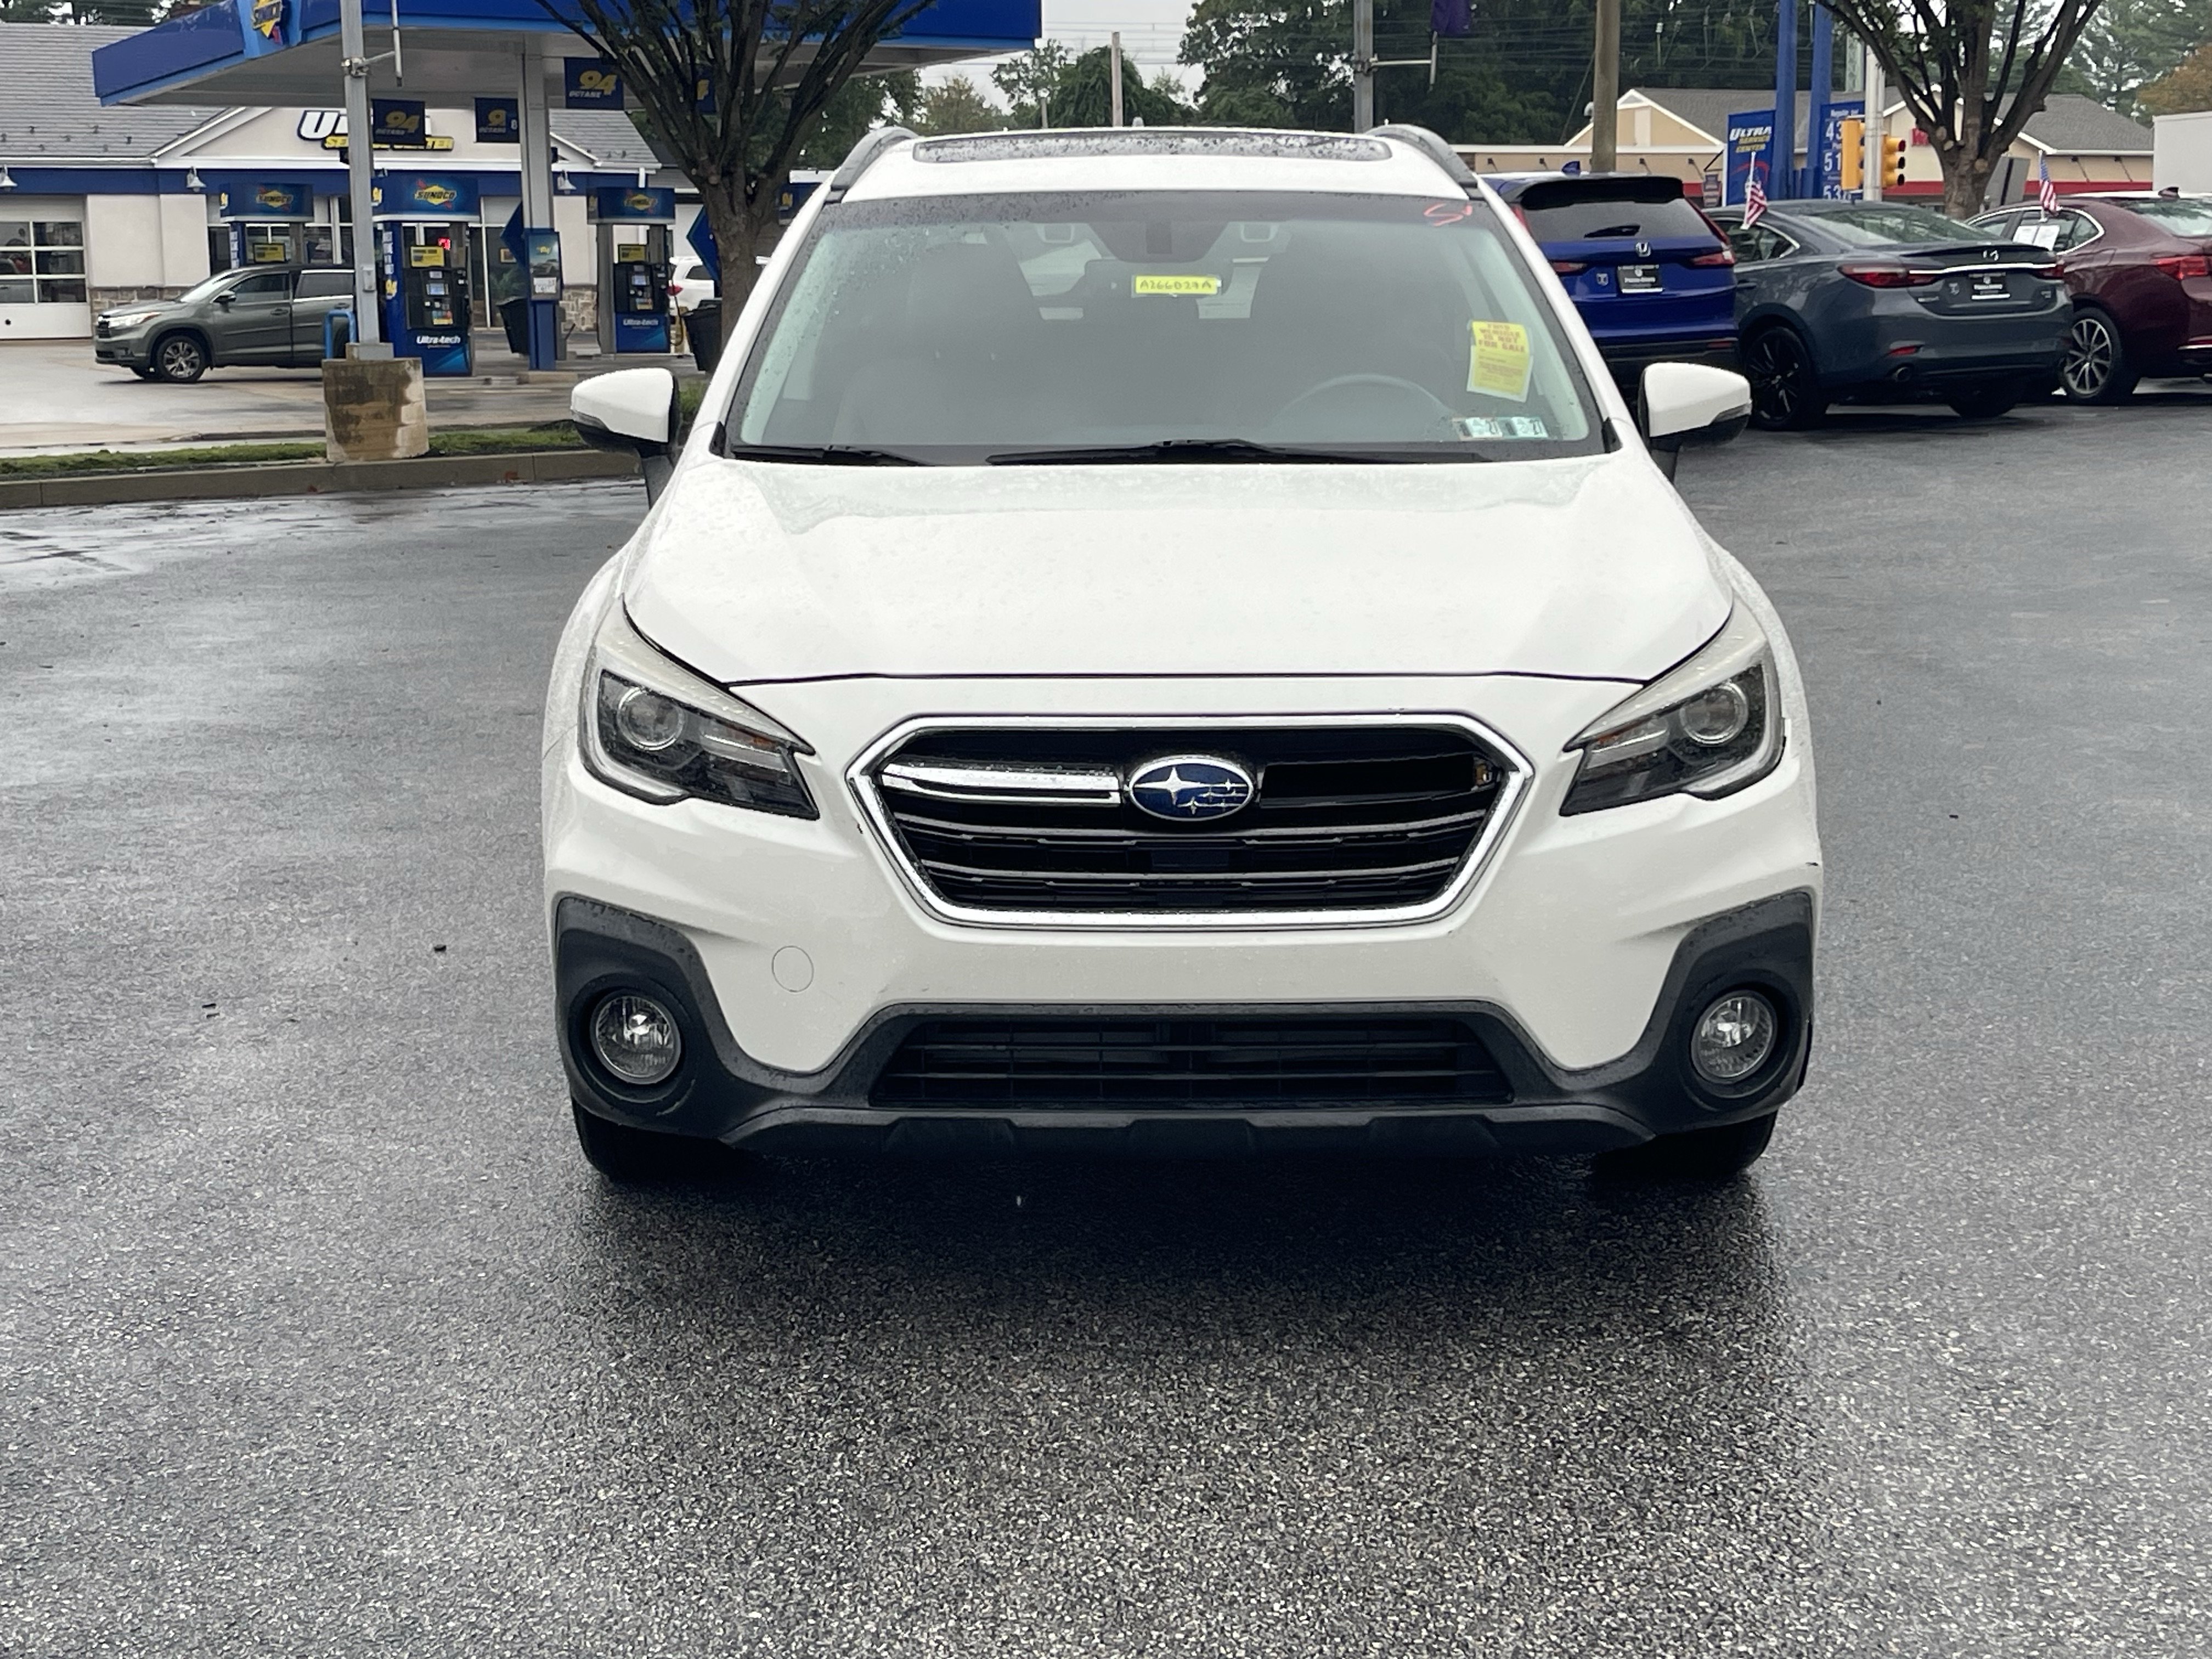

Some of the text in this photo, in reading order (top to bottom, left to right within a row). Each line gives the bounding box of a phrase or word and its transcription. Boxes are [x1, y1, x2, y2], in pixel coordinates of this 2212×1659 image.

[580, 70, 617, 95] 94
[569, 90, 602, 98] OCTANE
[386, 111, 420, 133] 94
[1729, 127, 1771, 142] ULTRA
[417, 191, 455, 199] SUNOCO
[1479, 339, 1498, 348] FOR
